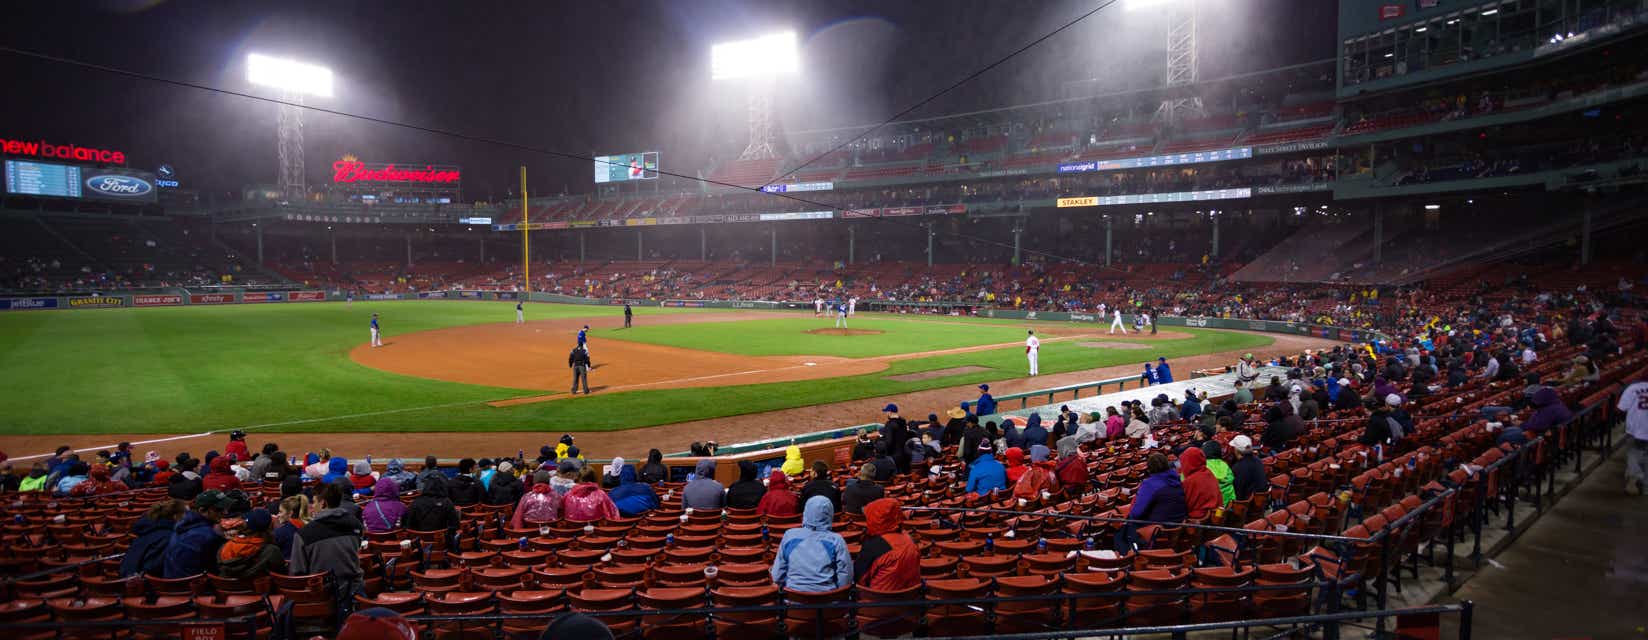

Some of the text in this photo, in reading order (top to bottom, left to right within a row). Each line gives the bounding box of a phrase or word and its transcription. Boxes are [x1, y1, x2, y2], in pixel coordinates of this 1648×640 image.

[42, 140, 125, 164] balance
[333, 160, 460, 183] Budweiser
[100, 177, 140, 193] Ford
